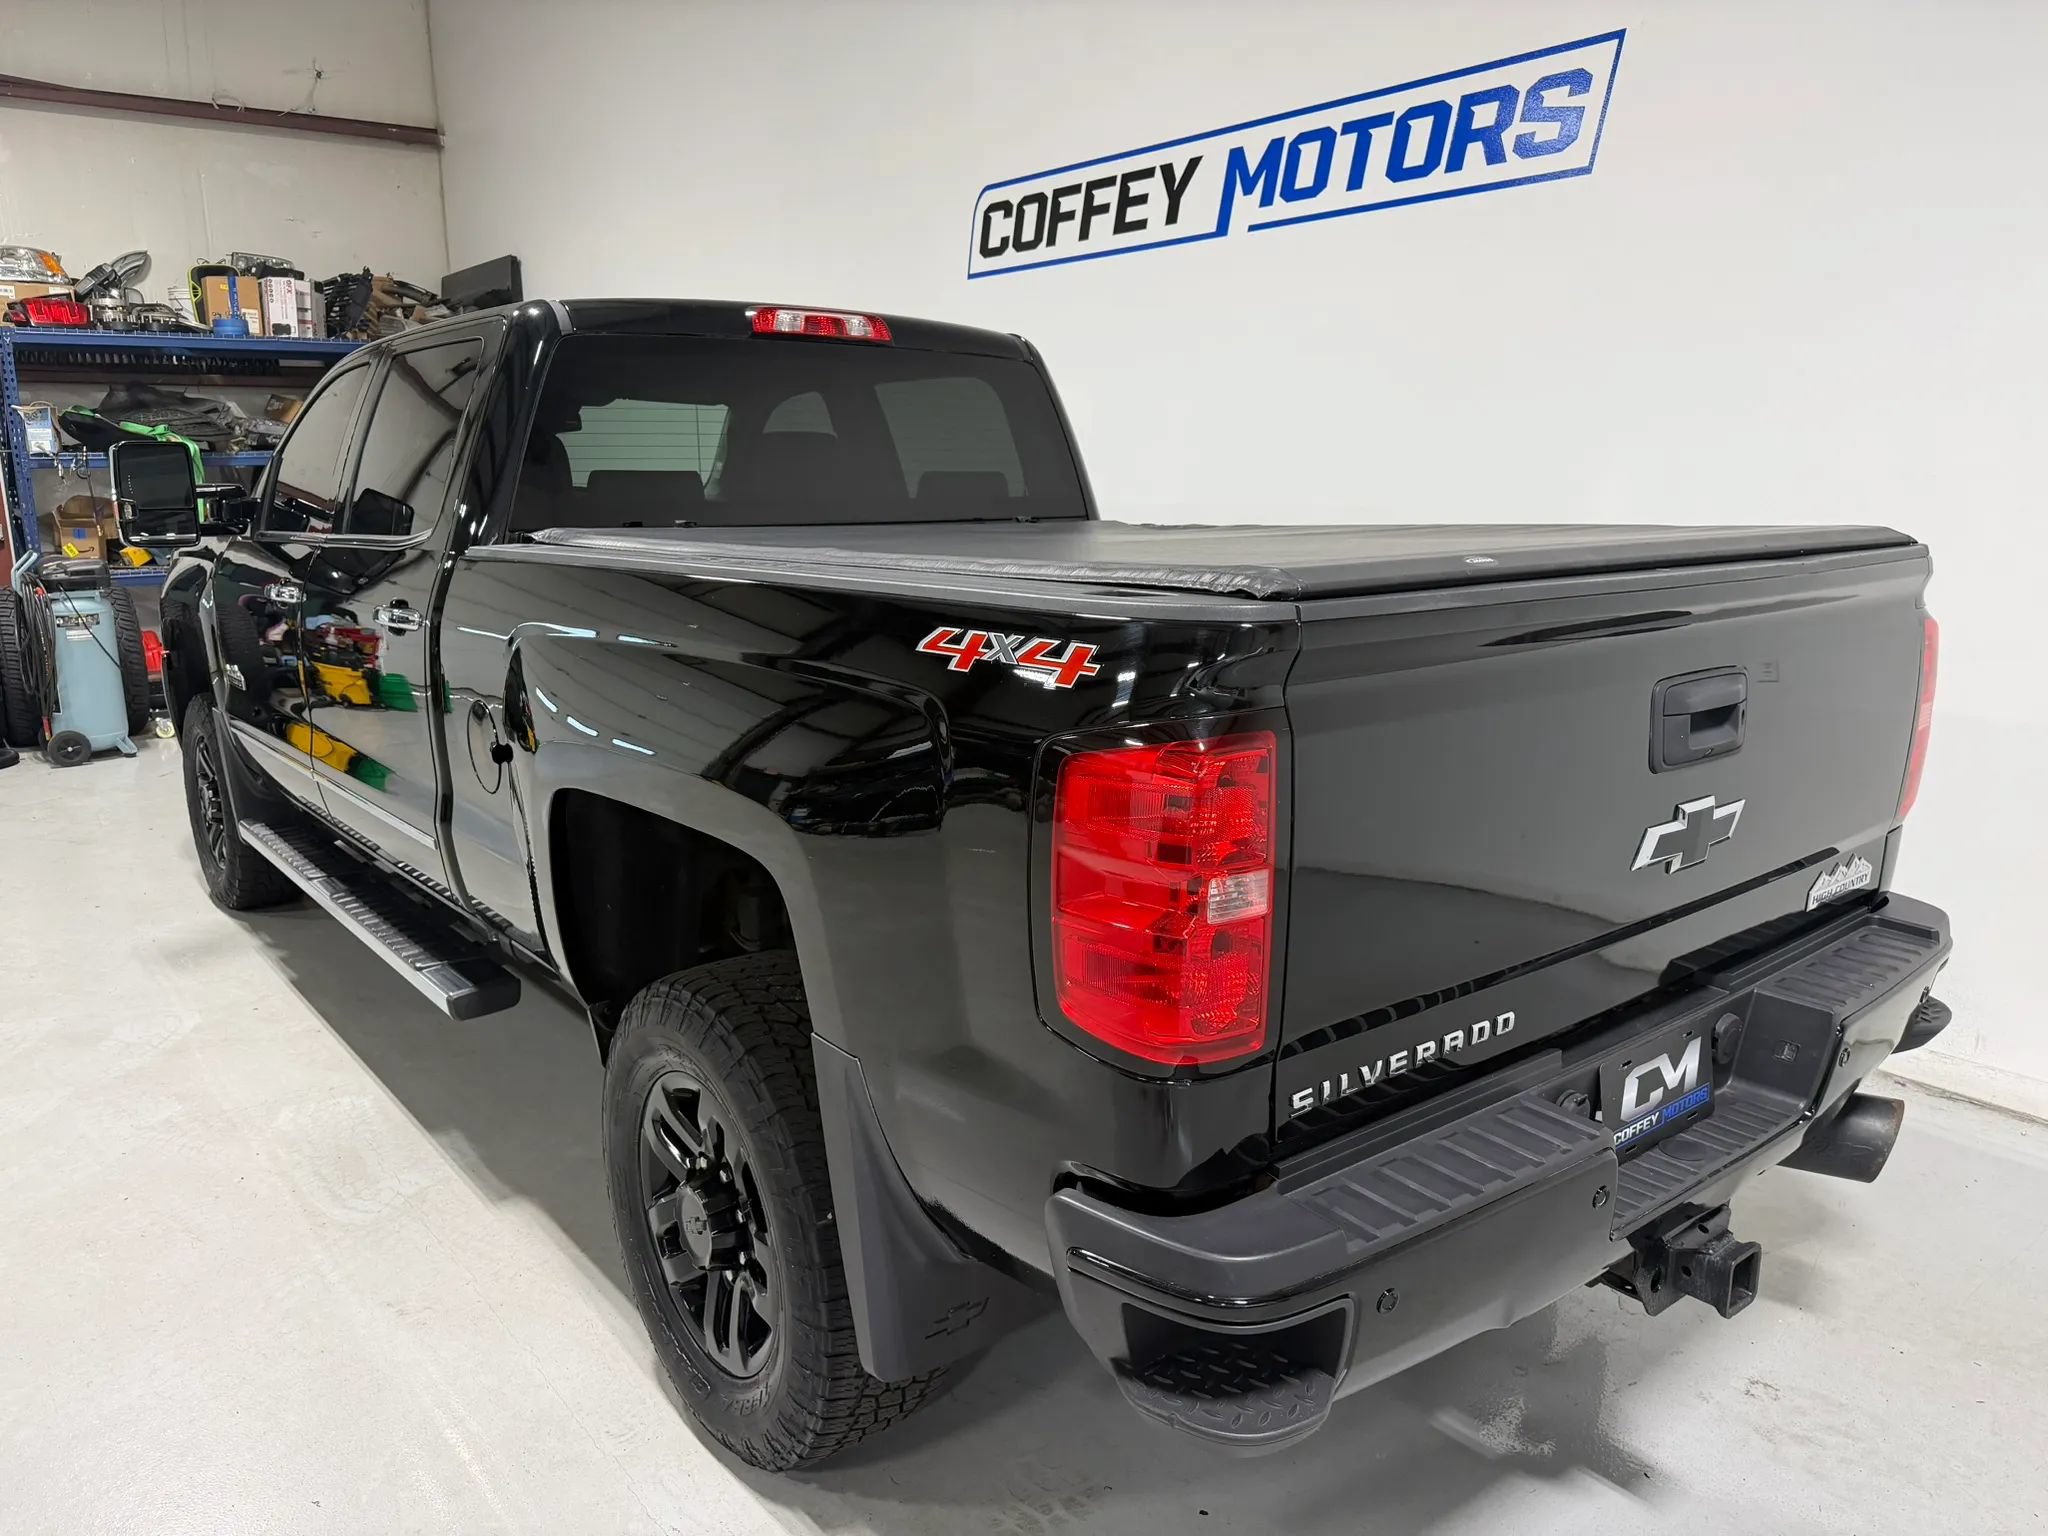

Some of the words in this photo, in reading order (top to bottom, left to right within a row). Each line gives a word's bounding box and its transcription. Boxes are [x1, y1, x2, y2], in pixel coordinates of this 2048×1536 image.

[979, 155, 1204, 259] COFFEY
[1217, 67, 1593, 236] MOTORS
[1811, 889, 1833, 905] HIGH
[1834, 872, 1868, 893] COUNTRY
[1288, 1011, 1515, 1119] SILVERADO
[1613, 1111, 1660, 1146] COFFEY
[1661, 1085, 1709, 1119] MOTORS
